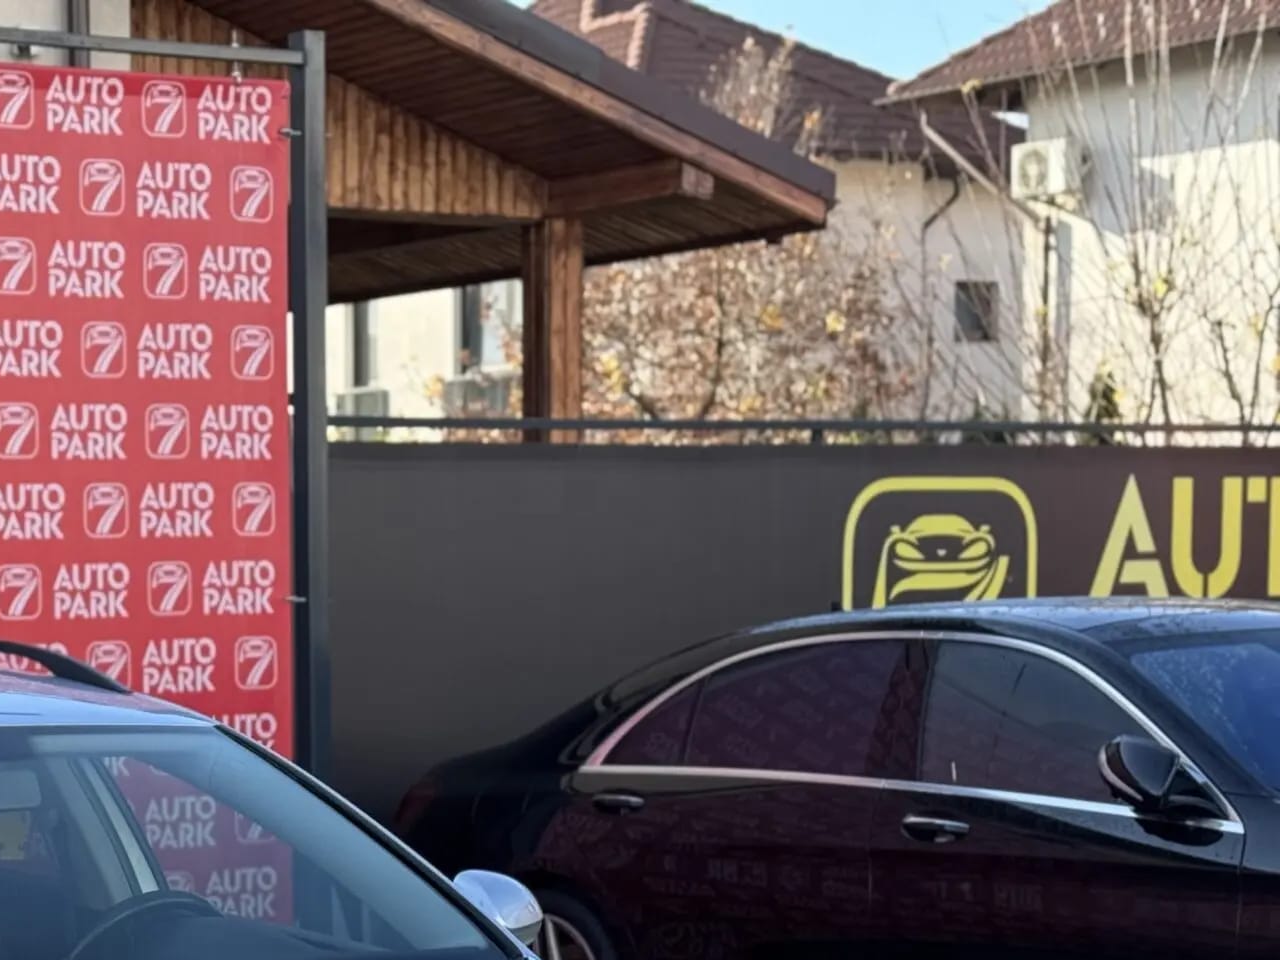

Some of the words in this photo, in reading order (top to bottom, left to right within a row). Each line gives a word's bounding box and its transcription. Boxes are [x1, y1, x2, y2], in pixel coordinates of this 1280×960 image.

[46, 77, 123, 106] AUTO
[197, 85, 271, 114] AUTO
[47, 102, 122, 135] PARK
[198, 110, 270, 144] PARK
[136, 162, 211, 191] AUTO
[137, 190, 209, 219] PARK
[48, 240, 125, 269] AUTO
[199, 246, 272, 274] AUTO
[48, 268, 123, 298] PARK
[200, 273, 270, 303] PARK
[137, 323, 212, 351] AUTO
[138, 350, 210, 379] PARK
[50, 403, 127, 432] AUTO
[200, 405, 273, 432] AUTO
[51, 431, 126, 459] PARK
[201, 431, 272, 460] PARK
[139, 482, 214, 510] AUTO
[140, 509, 212, 537] PARK
[53, 562, 130, 592] AUTO
[202, 560, 275, 588] AUTO
[54, 589, 128, 619] PARK
[203, 587, 274, 614] PARK
[143, 638, 216, 666] AUTO
[144, 663, 214, 691] PARK
[145, 796, 217, 823] AUTO
[146, 821, 217, 849] PARK
[206, 866, 277, 896] AUTO
